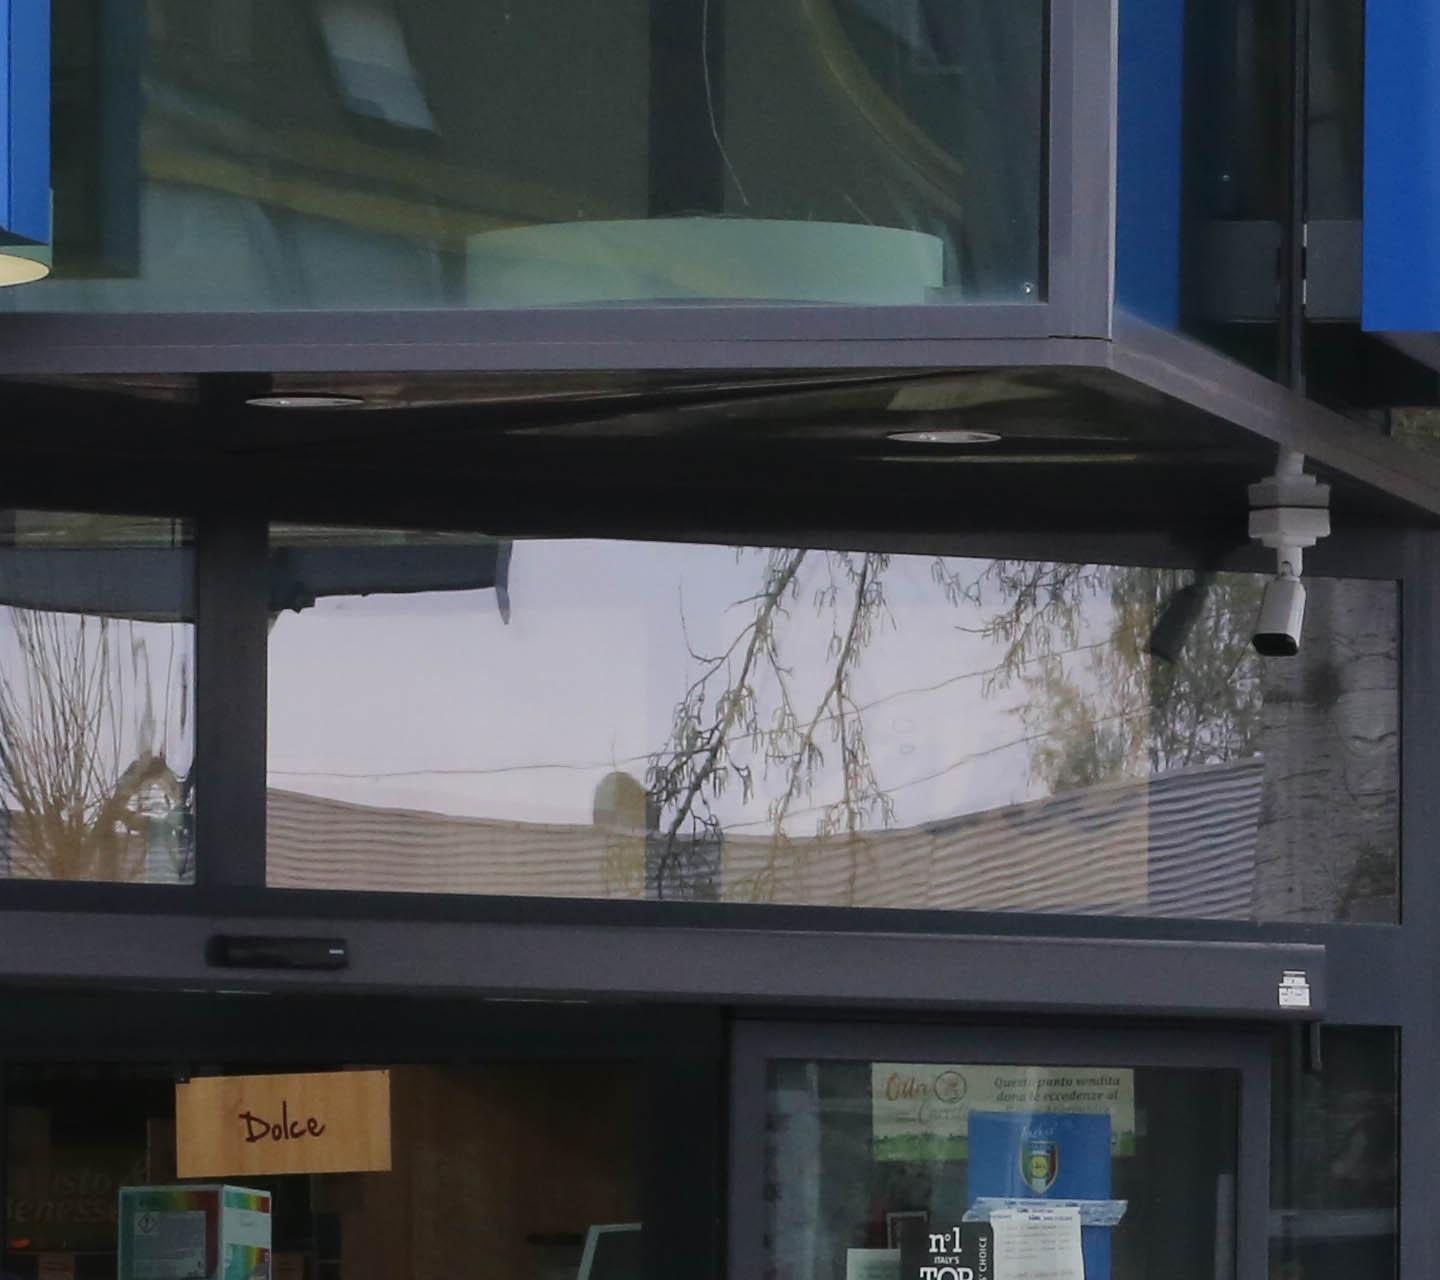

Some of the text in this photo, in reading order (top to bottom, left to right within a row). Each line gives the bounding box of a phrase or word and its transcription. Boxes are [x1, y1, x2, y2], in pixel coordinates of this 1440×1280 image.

[237, 1101, 326, 1145] Dolce
[934, 1256, 959, 1265] ITALY'S
[979, 1236, 988, 1272] CHOICE
